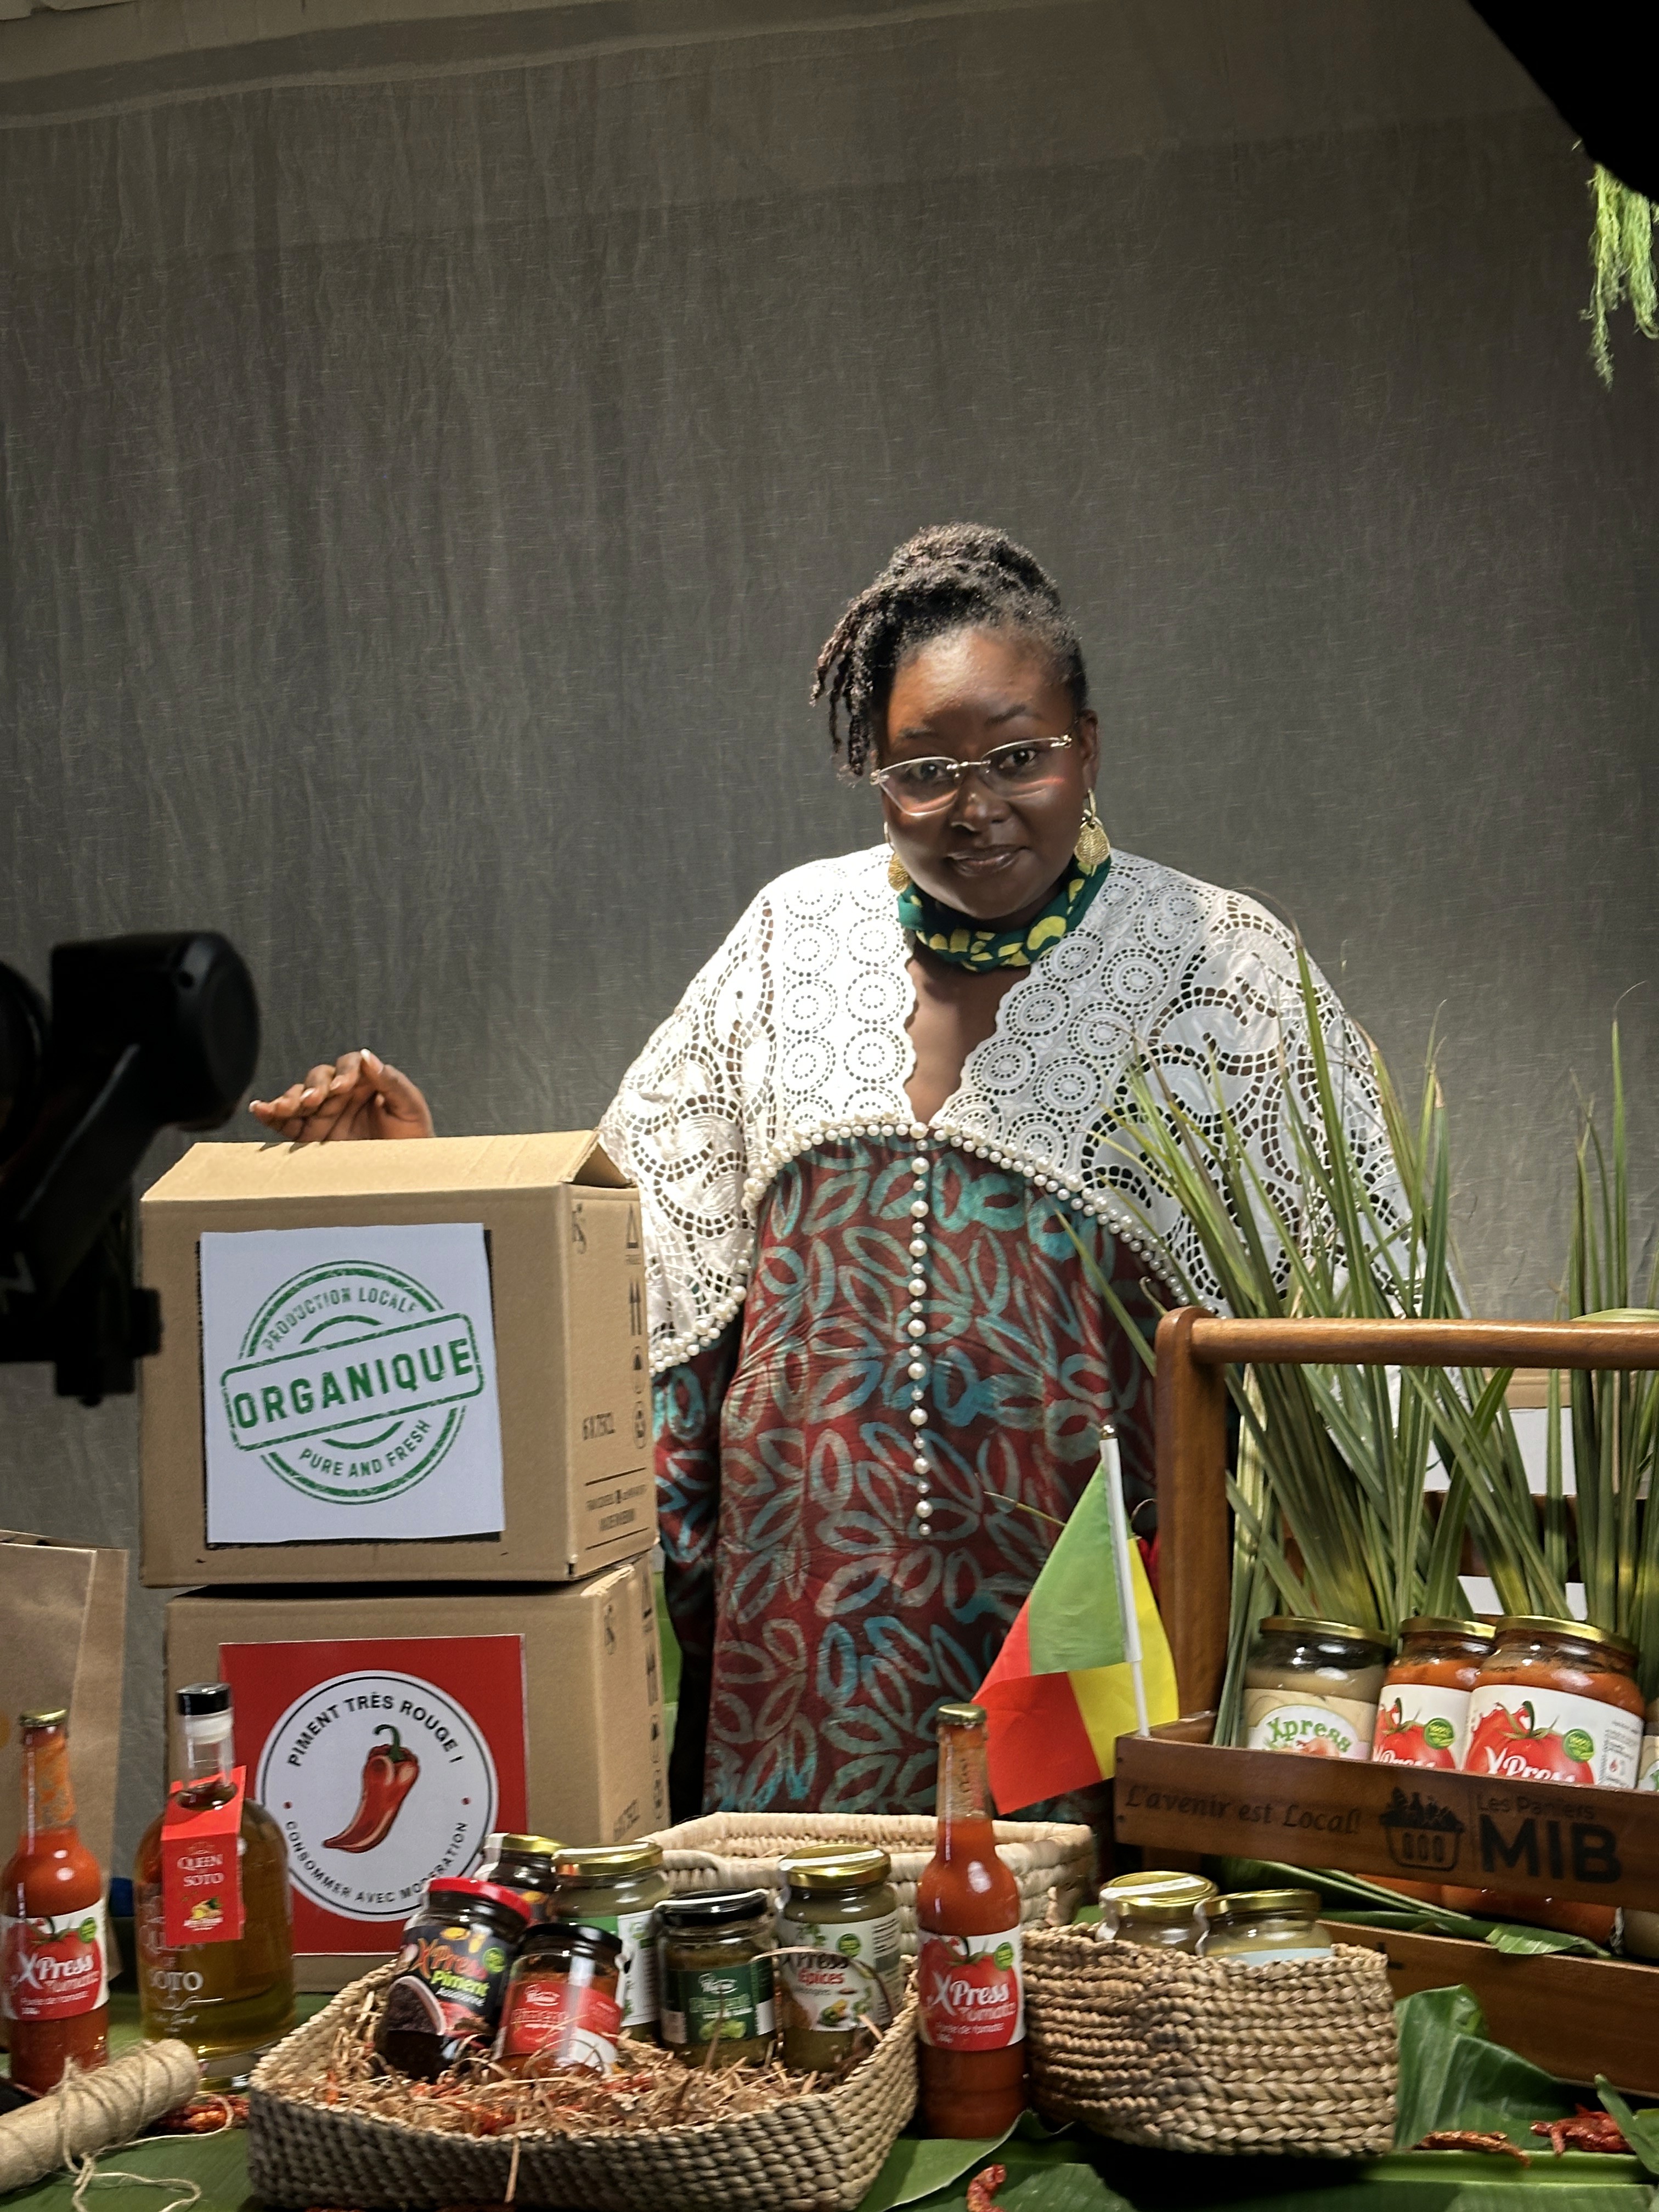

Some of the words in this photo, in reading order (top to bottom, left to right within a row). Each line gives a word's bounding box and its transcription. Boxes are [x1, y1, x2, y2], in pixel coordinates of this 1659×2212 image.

[261, 1287, 351, 1351] PRODUCTION
[358, 1287, 417, 1313] LOCALE
[232, 1338, 475, 1429] ORGANIQUE
[299, 1448, 343, 1476] PURE
[347, 1458, 383, 1477] AND
[385, 1419, 432, 1466] FRESH
[287, 1704, 340, 1767] PIMENT
[343, 1691, 393, 1712] TRÈS
[399, 1700, 459, 1752] ROUGE
[1266, 1717, 1352, 1753] Xpress
[1238, 1803, 1274, 1825] est
[1476, 1794, 1510, 1813] Les
[177, 1854, 223, 1871] QUEEN
[285, 1820, 352, 1898] CONSOMMER
[354, 1892, 396, 1904] AVEC
[1480, 1813, 1622, 1883] MIB
[183, 1872, 225, 1887] SOTO
[932, 1971, 1009, 2016] XPress
